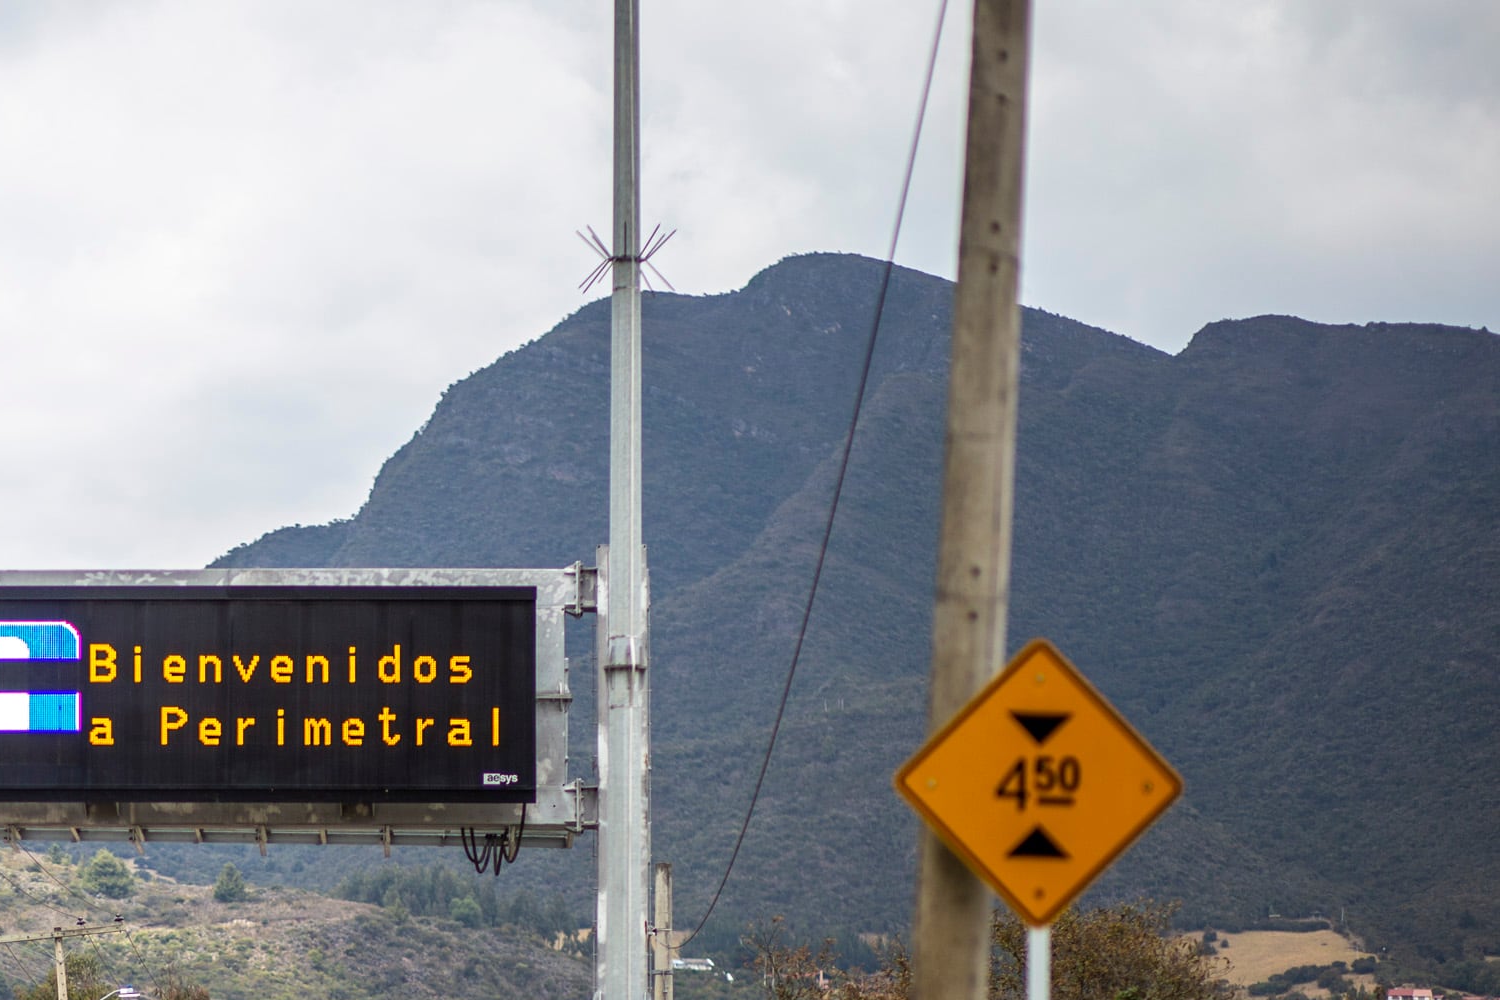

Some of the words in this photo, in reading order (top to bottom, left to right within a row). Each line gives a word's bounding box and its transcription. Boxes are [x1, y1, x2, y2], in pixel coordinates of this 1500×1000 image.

[89, 644, 473, 684] Bienvenidos
[88, 718, 115, 746] a
[160, 706, 500, 747] Perimetral
[486, 773, 519, 785] aesys
